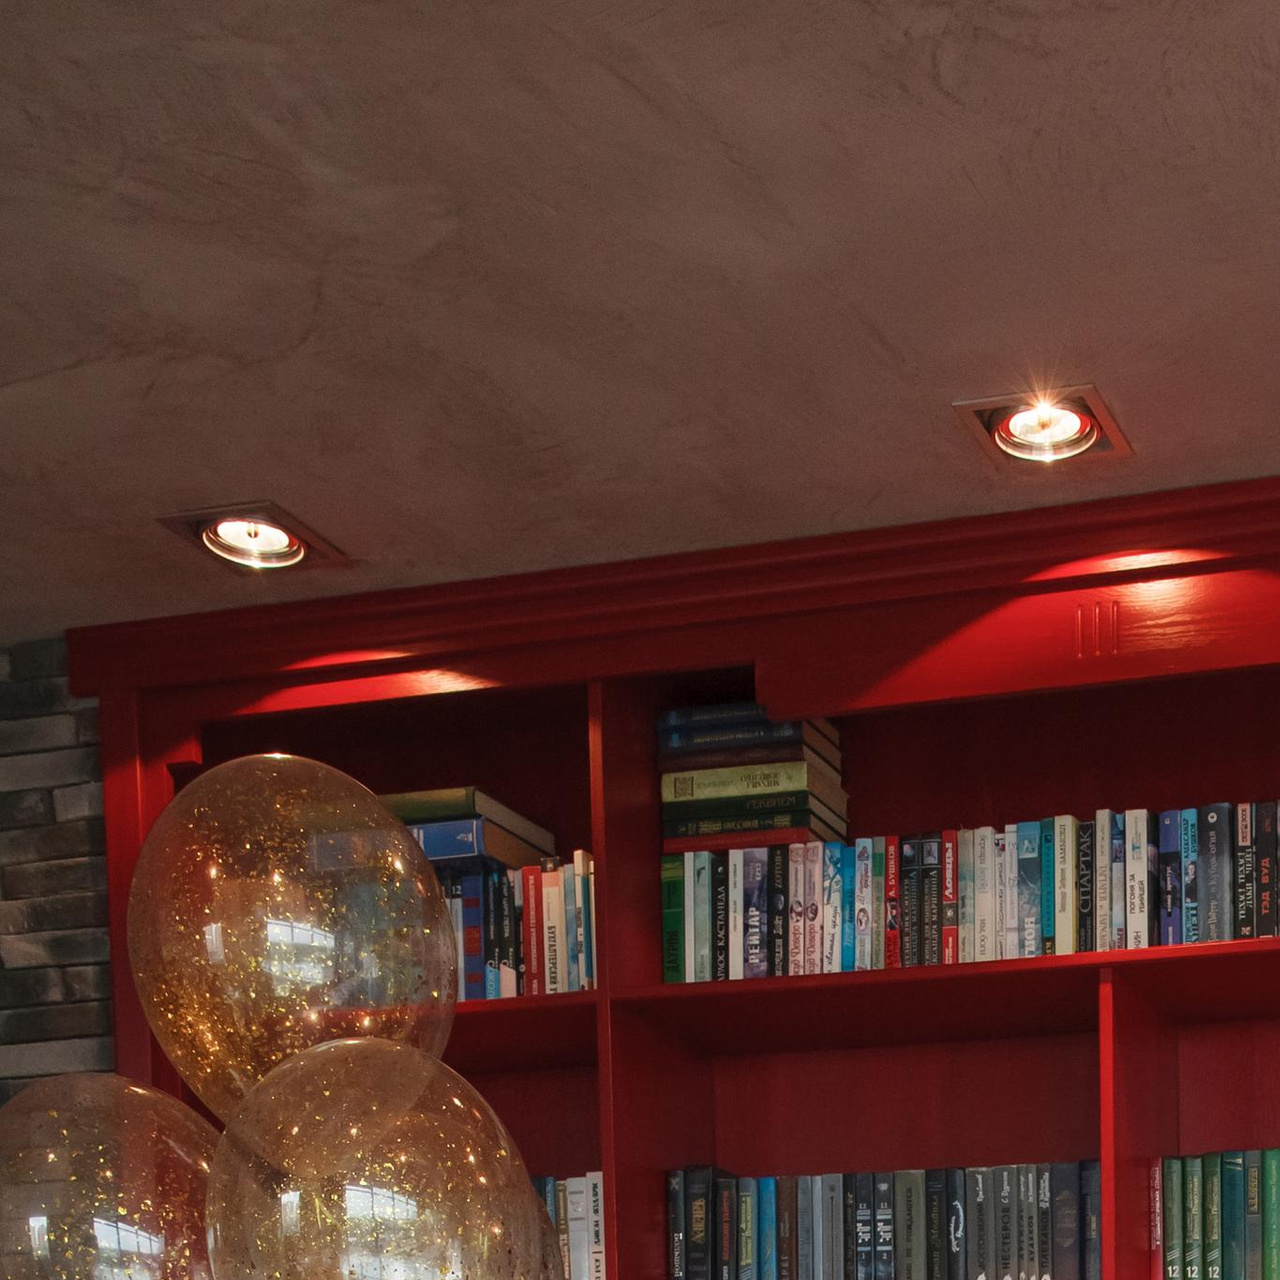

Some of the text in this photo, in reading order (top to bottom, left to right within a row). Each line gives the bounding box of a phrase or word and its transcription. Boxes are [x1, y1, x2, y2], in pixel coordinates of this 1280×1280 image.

[1079, 828, 1091, 913] СПАРТАК
[1001, 1207, 1011, 1270] НЕСТЕРОВ
[1167, 1265, 1180, 1278] 12
[1186, 1265, 1199, 1278] 12
[1207, 1266, 1220, 1279] 12
